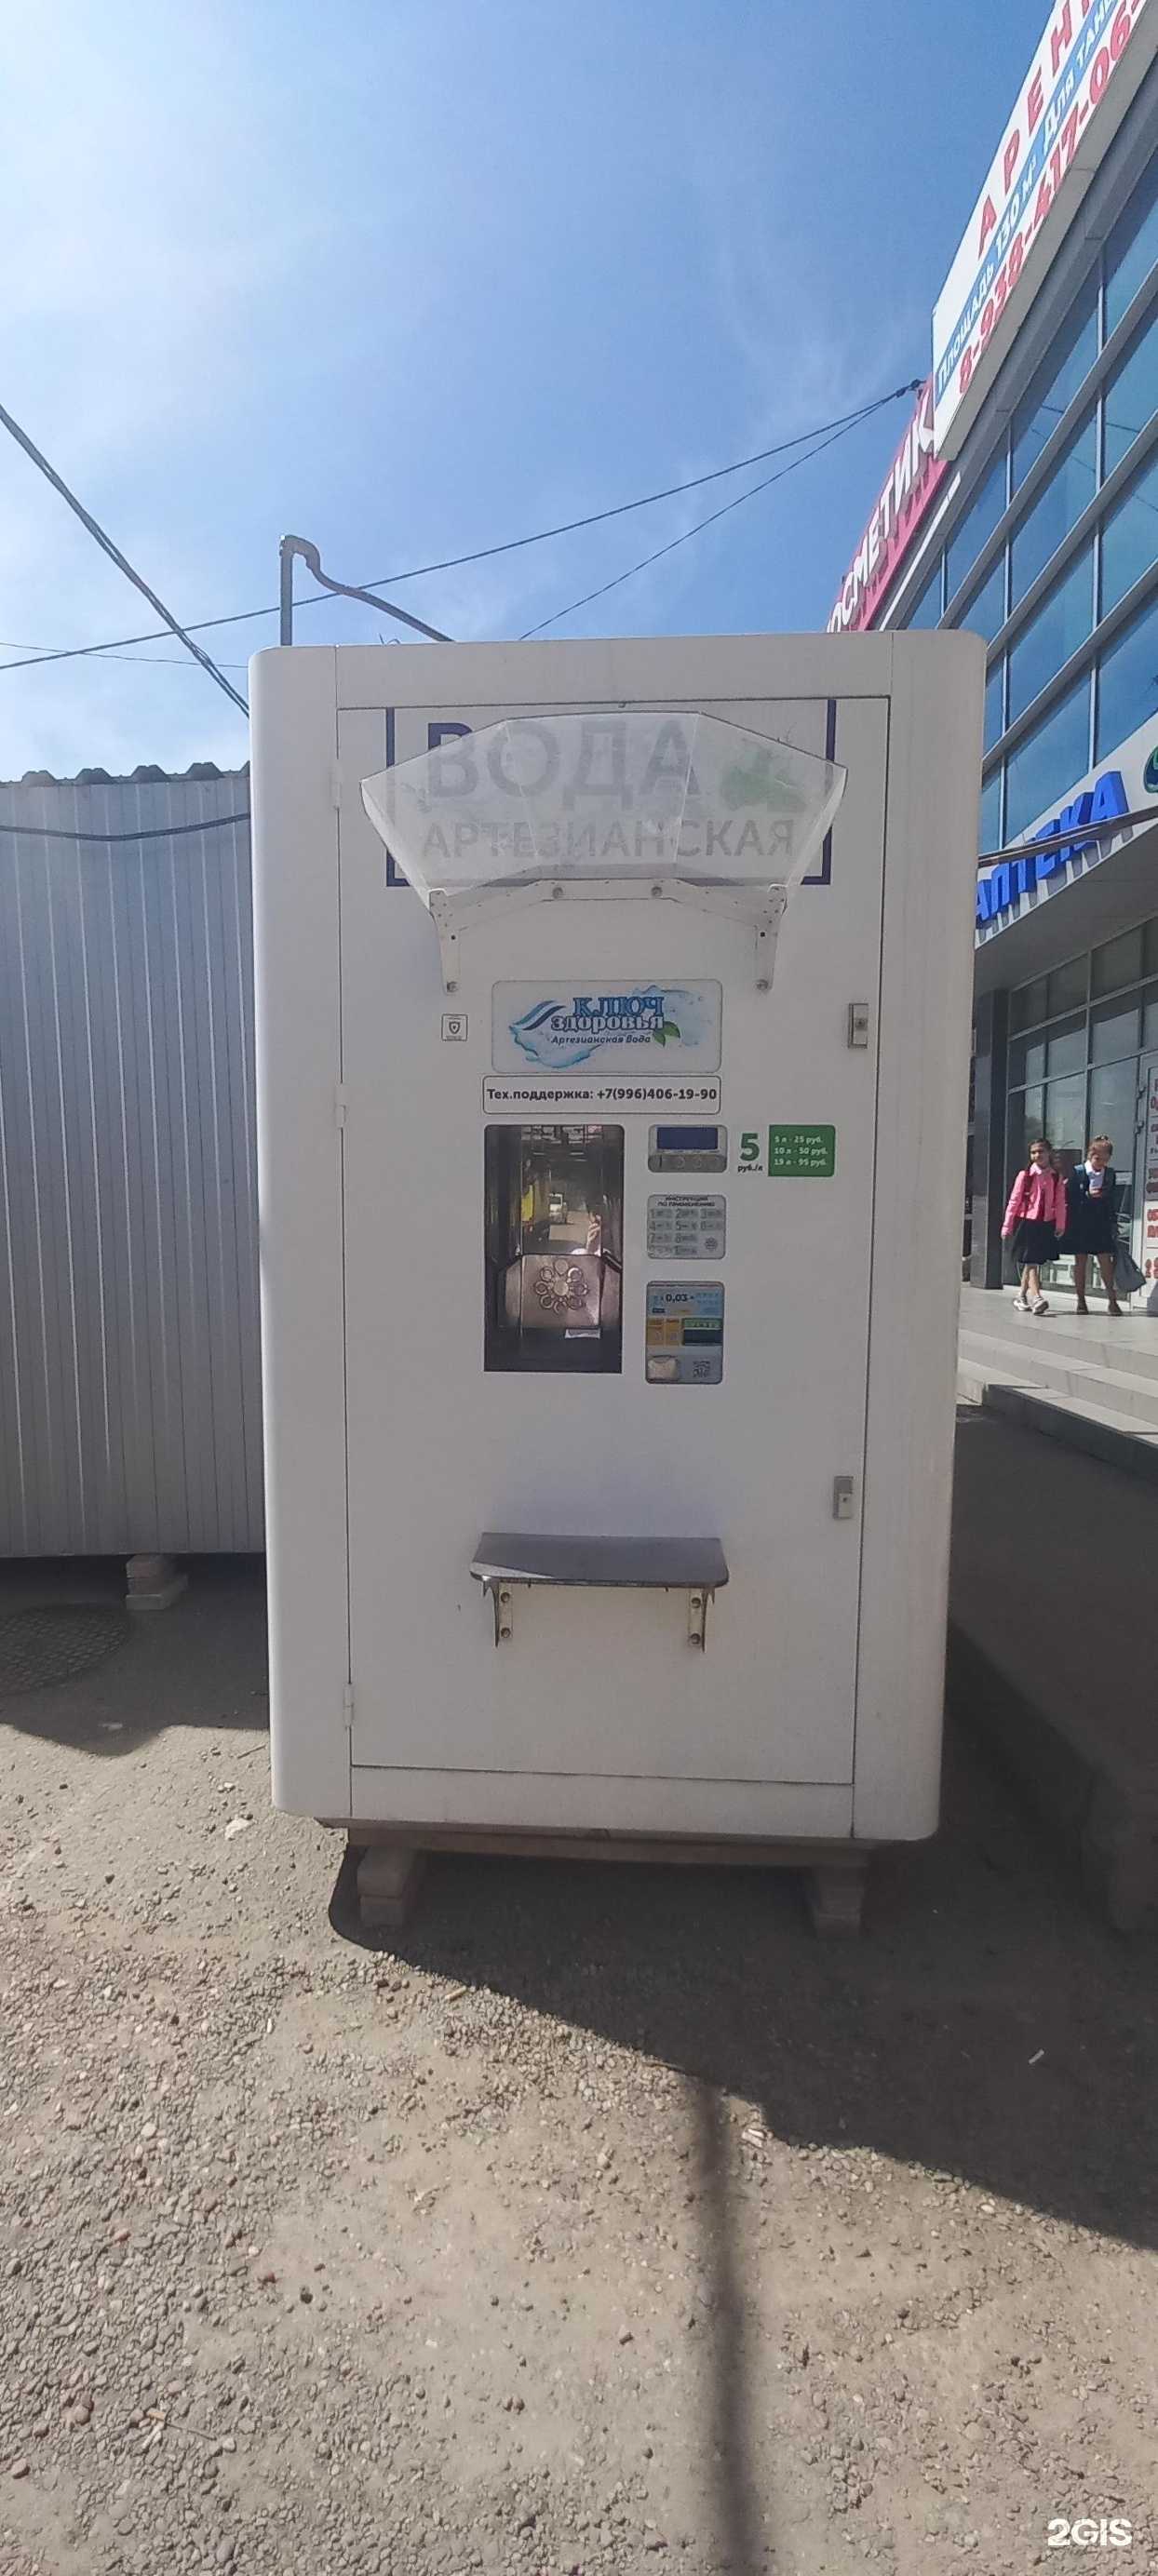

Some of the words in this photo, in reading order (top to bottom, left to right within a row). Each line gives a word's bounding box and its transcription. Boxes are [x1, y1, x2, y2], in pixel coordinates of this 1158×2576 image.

[996, 194, 1020, 261] 130
[827, 389, 935, 633] ОСМЕТИК
[427, 719, 701, 812] ВОДА
[423, 819, 794, 858] АРТЕЗИАНСКАЯ
[572, 997, 665, 1016] КЛЮЧ
[486, 1088, 594, 1102] Тех.поддержка:
[597, 1088, 718, 1101] +7(996)406-19-90
[739, 1133, 761, 1161] 5
